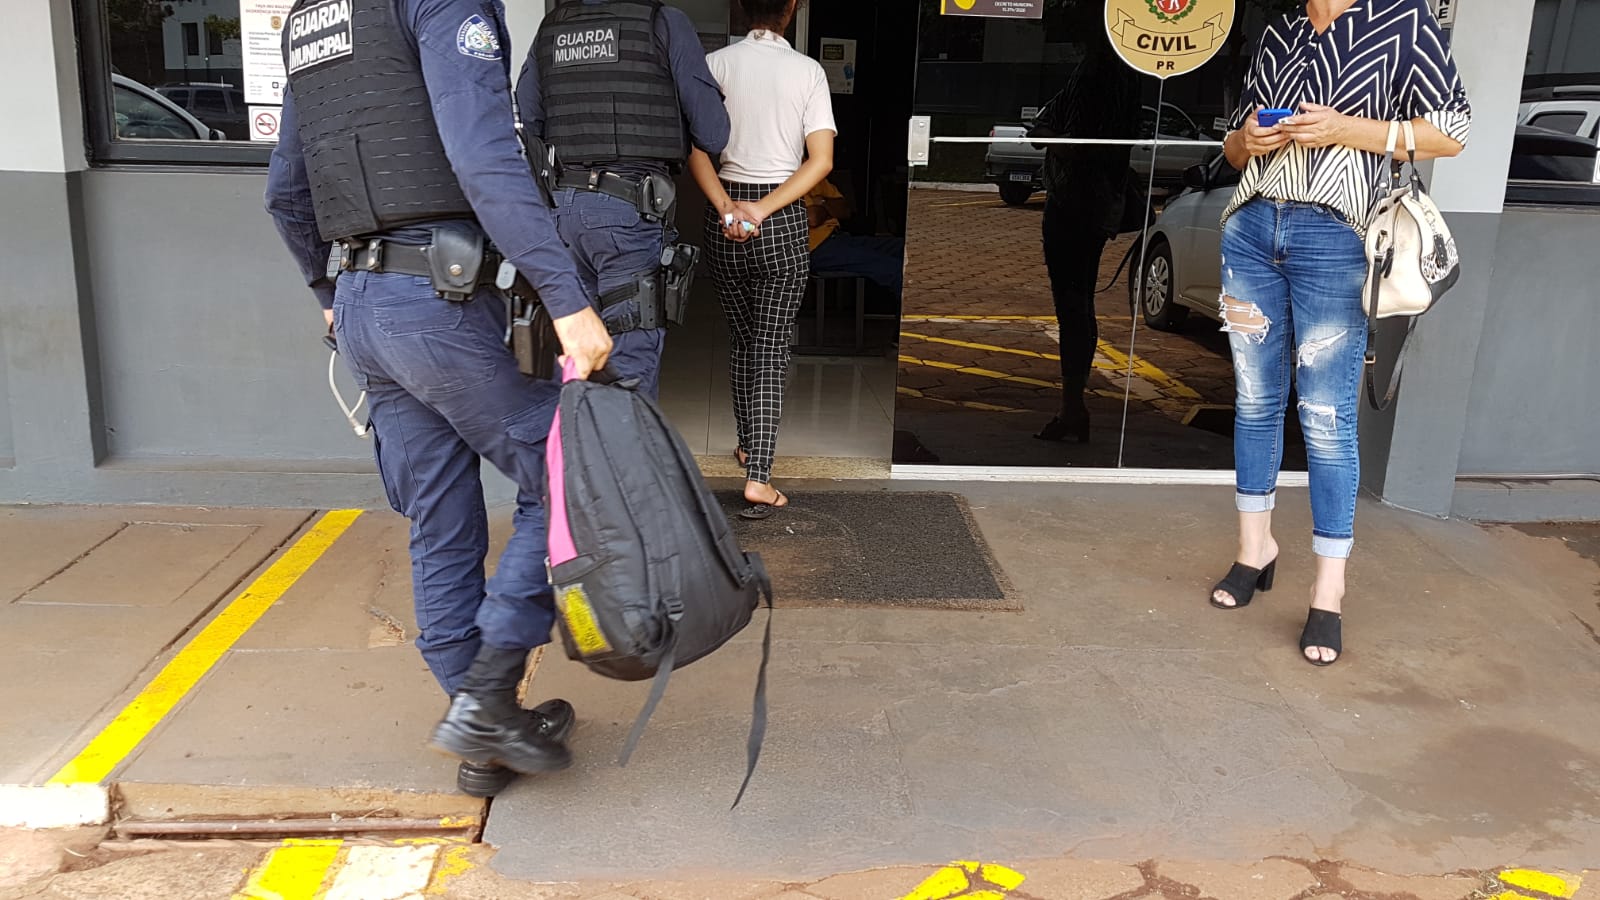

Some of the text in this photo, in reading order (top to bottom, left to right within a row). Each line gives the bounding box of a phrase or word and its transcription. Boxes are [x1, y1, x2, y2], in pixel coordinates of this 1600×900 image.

[292, 0, 349, 40] GUARDA
[557, 28, 614, 46] GUARDA
[1137, 33, 1197, 52] CIVIL
[291, 32, 351, 69] MUNICIPAL
[555, 43, 615, 64] MUNICIPAL
[1156, 61, 1175, 70] PR
